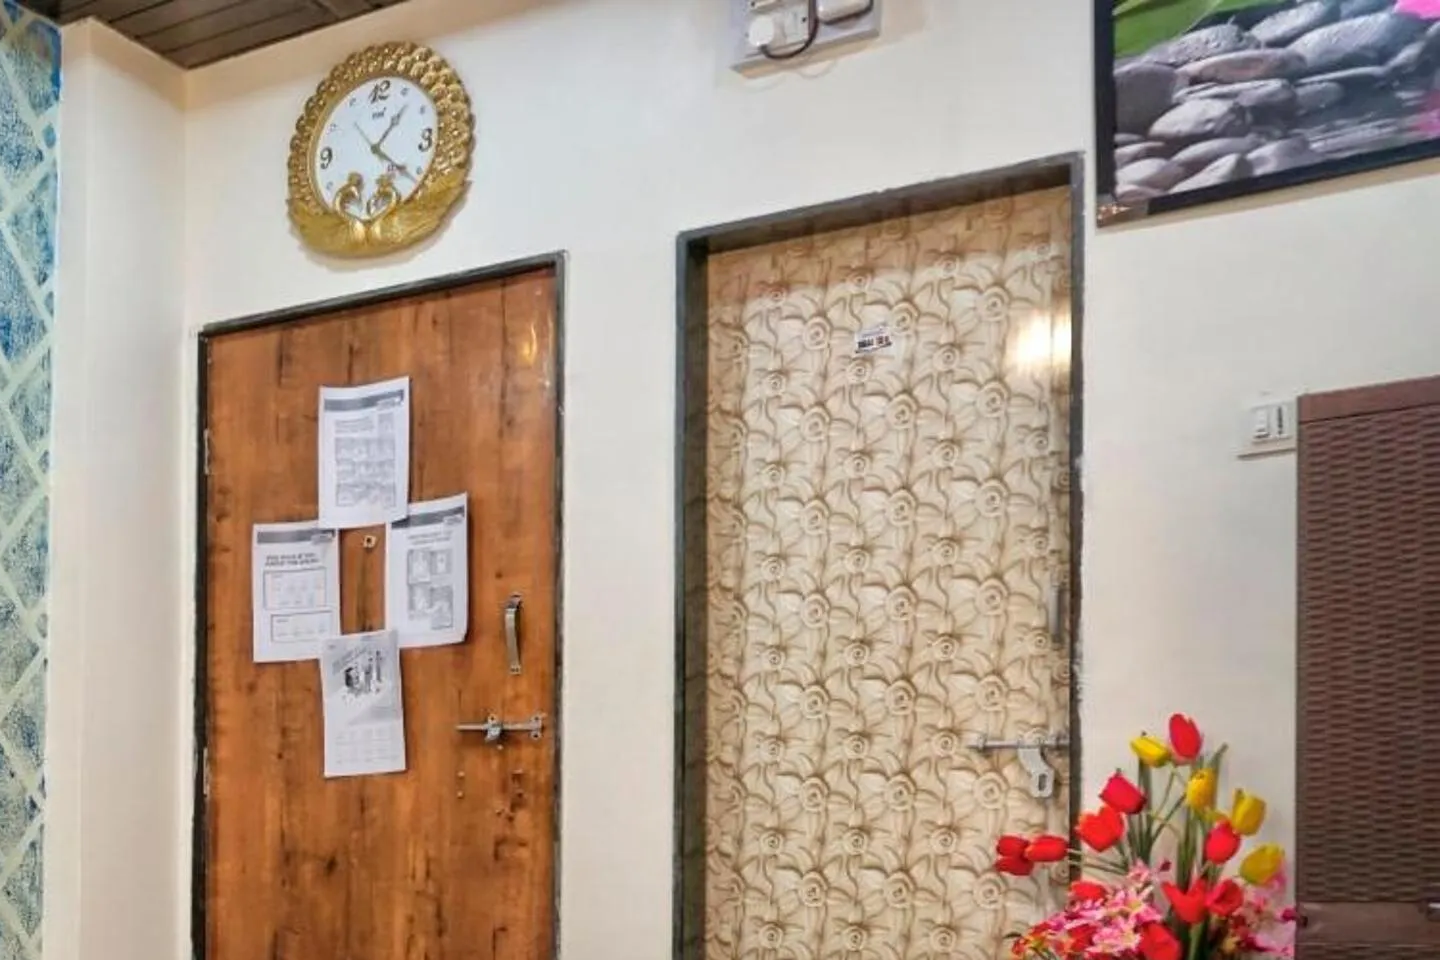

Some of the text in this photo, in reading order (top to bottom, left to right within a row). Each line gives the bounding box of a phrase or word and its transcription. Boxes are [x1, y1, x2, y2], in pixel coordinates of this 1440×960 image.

[368, 80, 391, 104] 12
[418, 128, 433, 152] 3
[320, 147, 333, 170] 9
